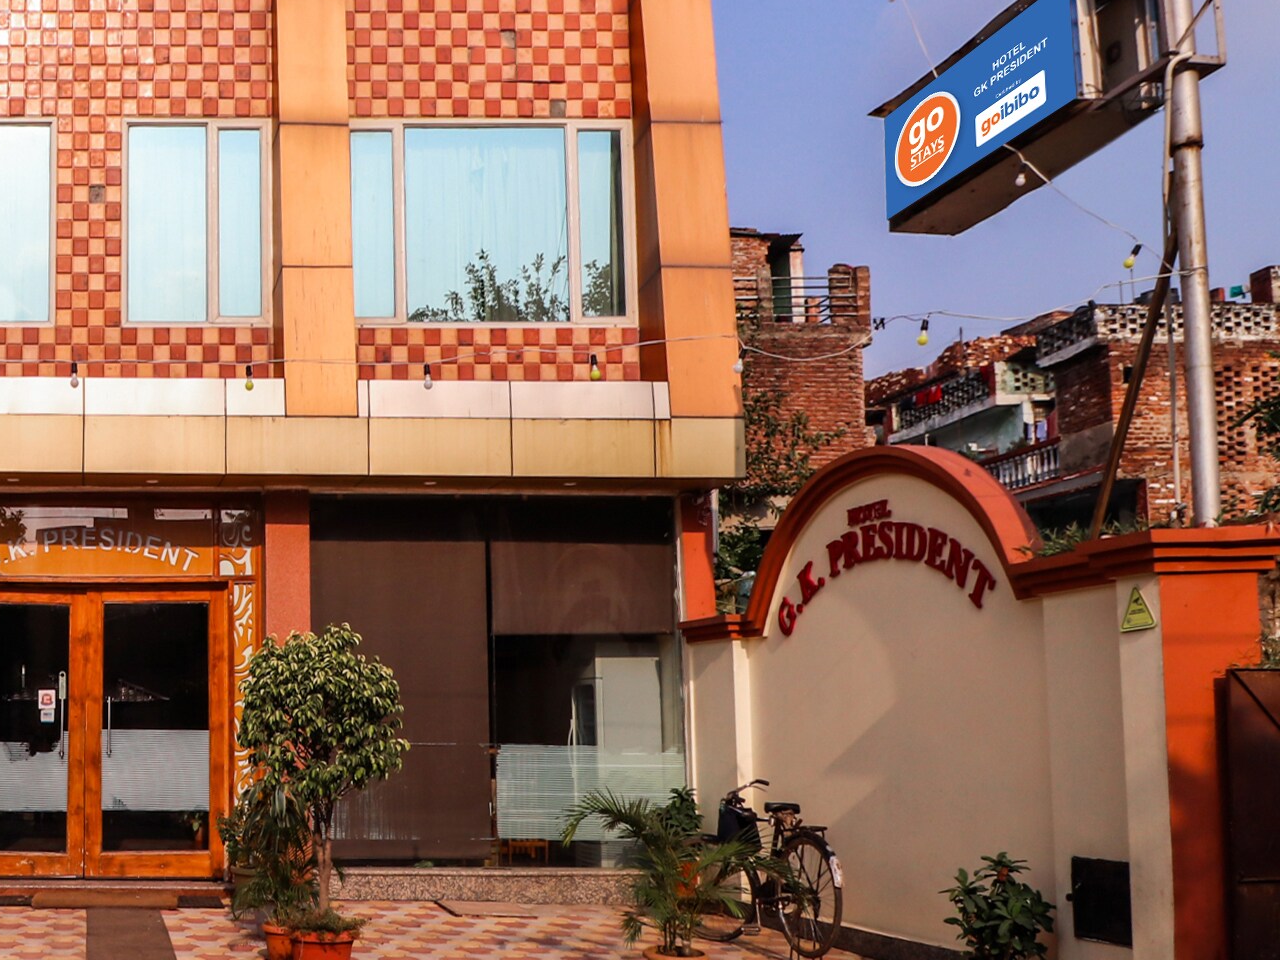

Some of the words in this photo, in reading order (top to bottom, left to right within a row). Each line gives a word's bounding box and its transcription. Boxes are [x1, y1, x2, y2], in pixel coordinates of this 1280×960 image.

[973, 80, 988, 97] GK
[990, 37, 1048, 86] PRESIDENT
[992, 42, 1026, 71] HOTEL
[909, 106, 944, 155] go
[981, 86, 1040, 137] goibibo
[910, 135, 945, 168] STAYS
[43, 526, 200, 572] PRESIDENT
[778, 560, 825, 637] G.K.
[825, 520, 997, 610] PRESIDENT
